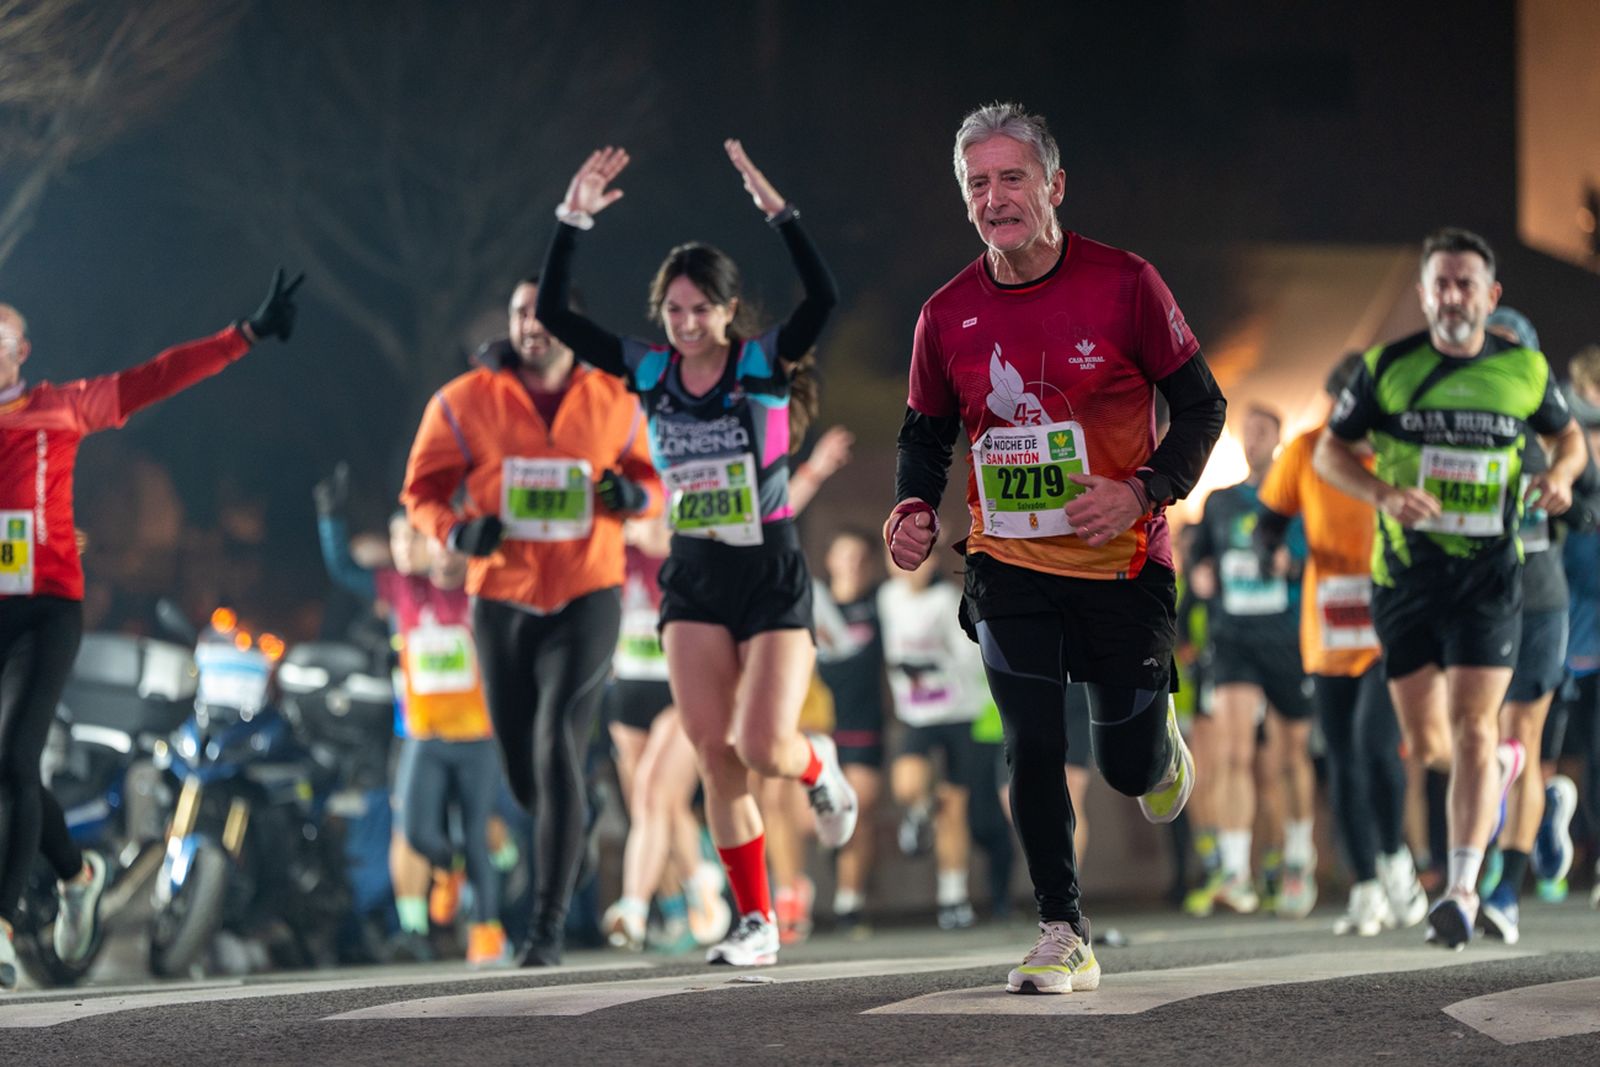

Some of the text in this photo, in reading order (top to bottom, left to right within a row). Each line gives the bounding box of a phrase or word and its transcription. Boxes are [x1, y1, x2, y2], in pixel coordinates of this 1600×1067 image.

[994, 439, 1038, 451] NOCHE DE
[986, 453, 1004, 465] SAN
[1005, 450, 1039, 465] ANTÓN
[997, 464, 1065, 500] 2279
